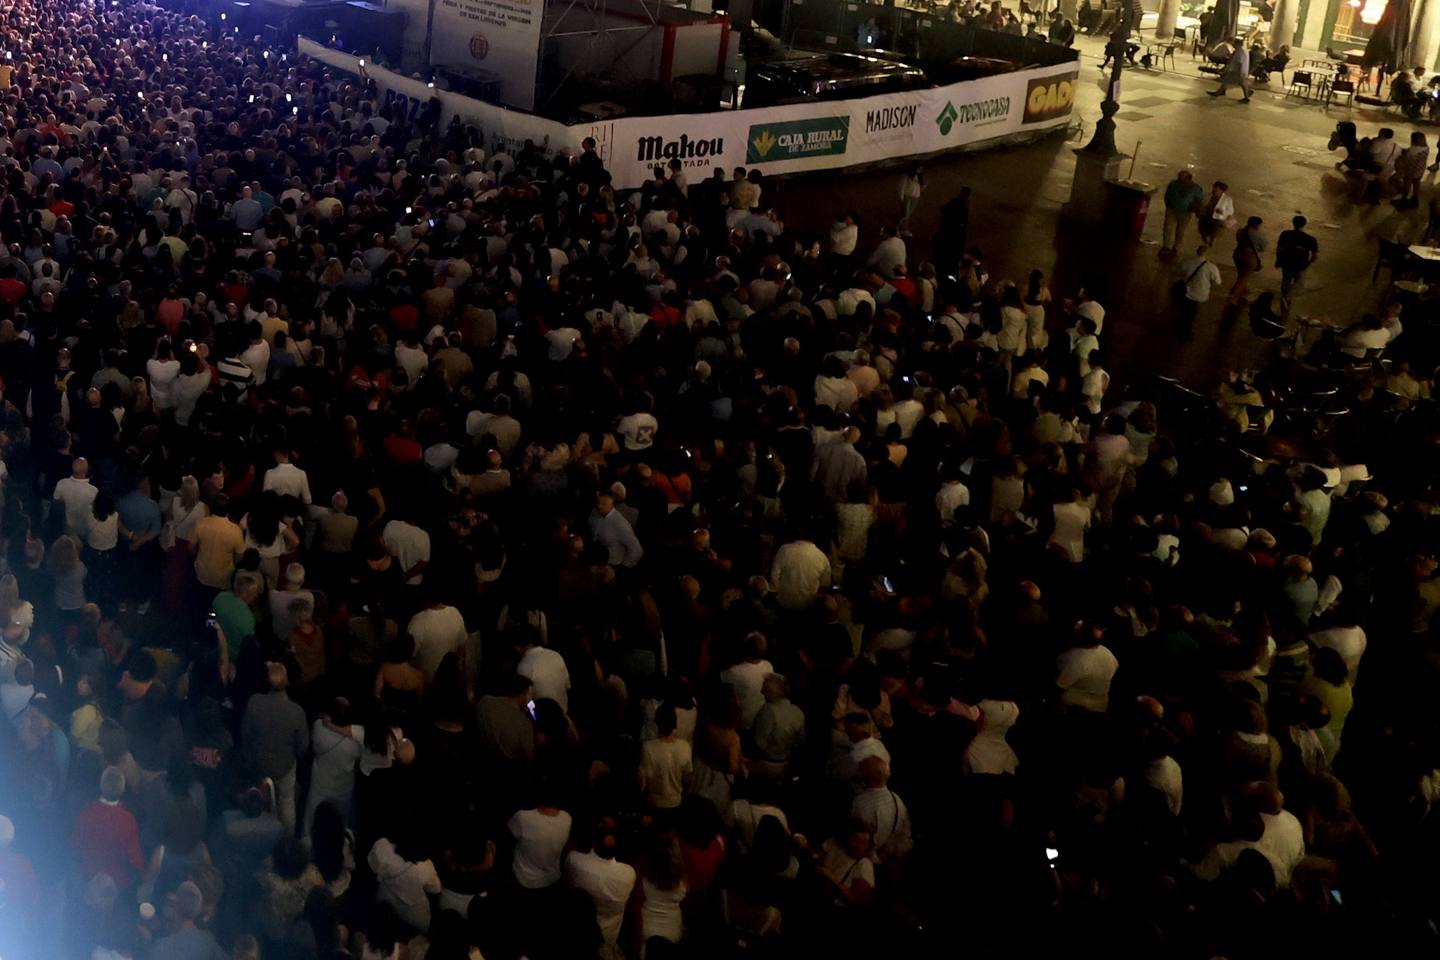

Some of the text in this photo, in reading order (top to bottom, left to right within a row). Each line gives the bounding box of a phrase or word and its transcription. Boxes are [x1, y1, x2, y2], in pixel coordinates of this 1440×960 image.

[866, 105, 916, 133] MADISON
[638, 134, 723, 161] Mahou
[778, 129, 845, 147] CAJA RURAL
